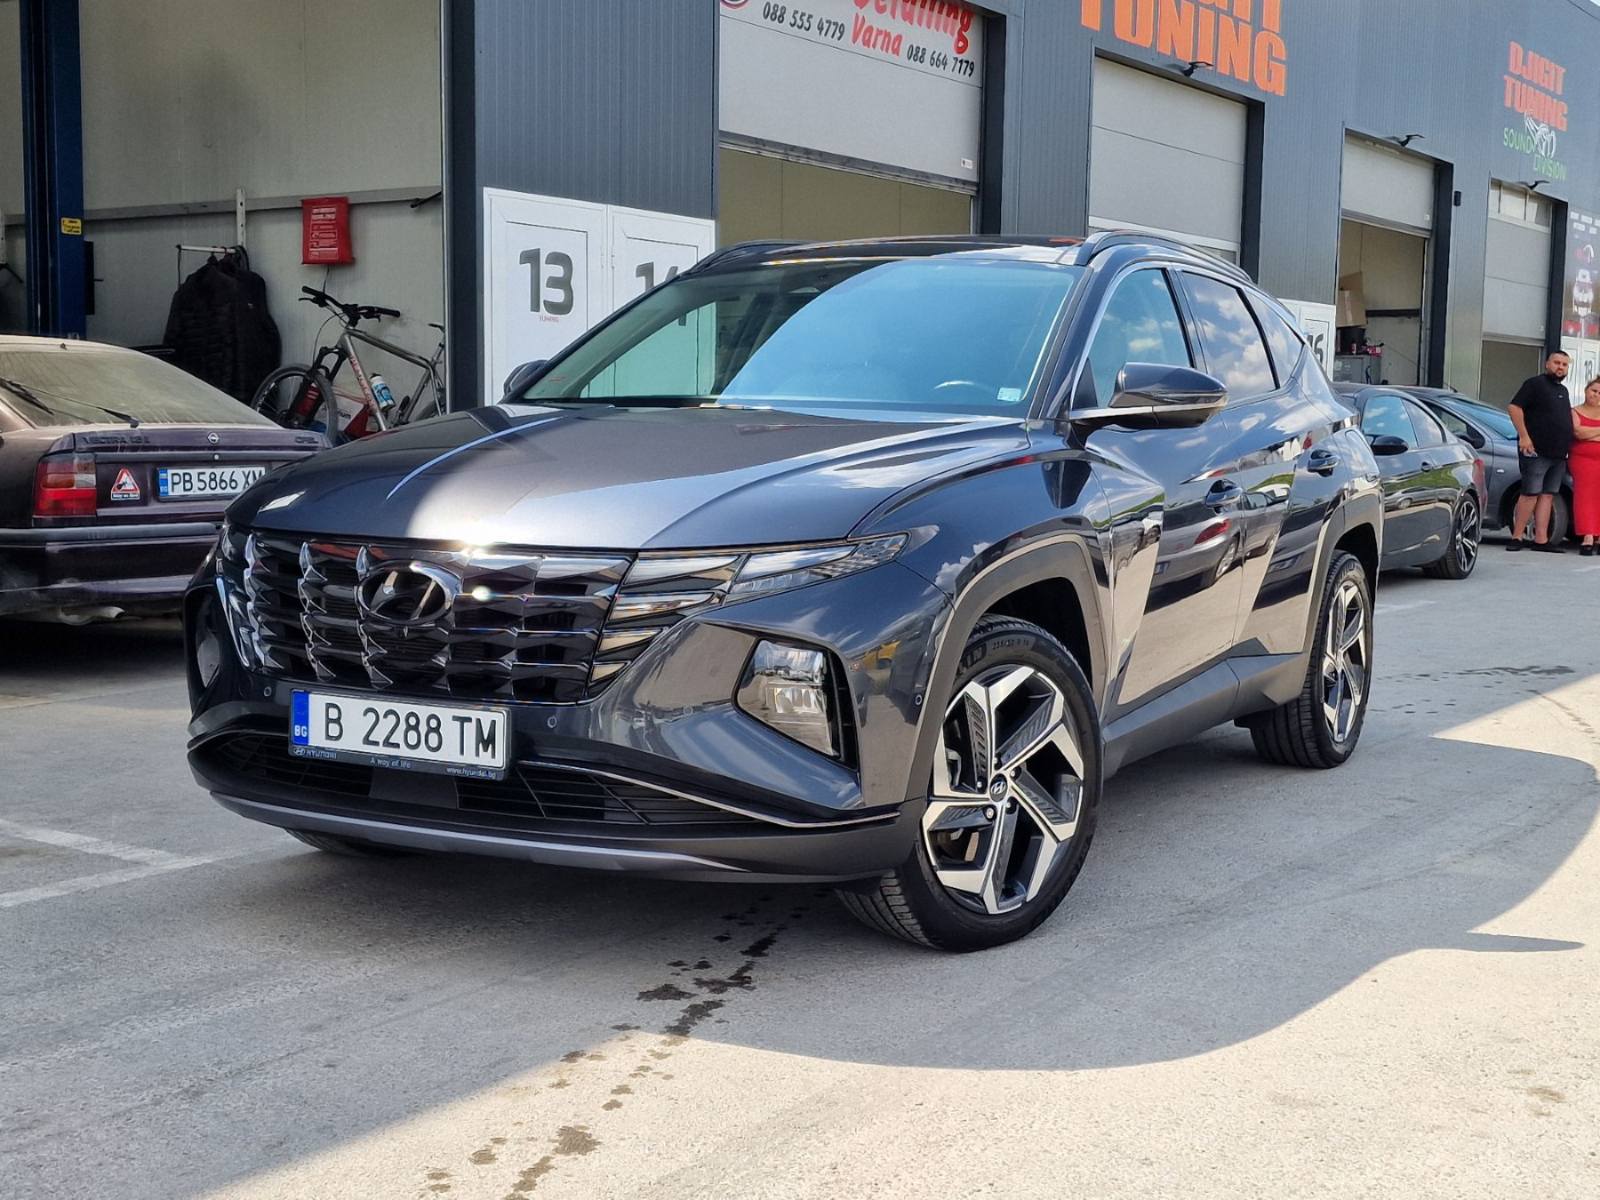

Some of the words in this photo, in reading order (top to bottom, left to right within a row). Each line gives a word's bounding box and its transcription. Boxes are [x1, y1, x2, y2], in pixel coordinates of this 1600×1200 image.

[763, 2, 786, 24] 088
[789, 10, 813, 31] 555
[817, 18, 845, 41] 4779
[851, 12, 903, 57] Varna
[854, 0, 975, 54] ailing
[906, 44, 926, 64] 088
[929, 50, 948, 71] 664
[951, 57, 975, 77] 7179
[1503, 75, 1568, 132] TUNING
[1503, 127, 1534, 154] SOUND
[519, 248, 574, 316] 13
[171, 472, 193, 492] PB
[197, 470, 238, 491] 5866
[294, 725, 308, 738] BG
[324, 702, 343, 742] B
[362, 707, 443, 753] 2288
[452, 715, 497, 760] TM
[370, 757, 376, 765] A
